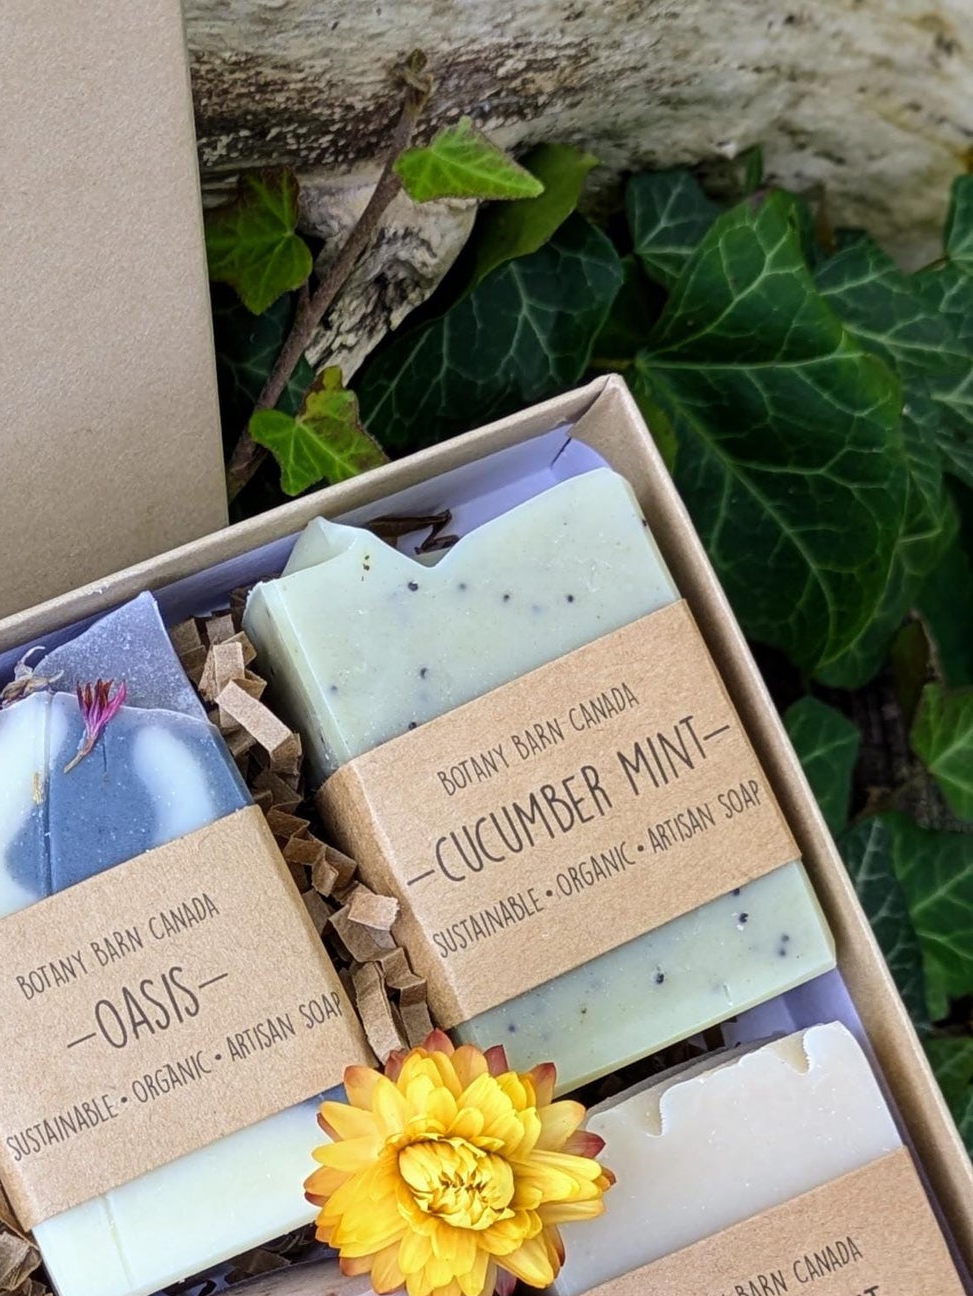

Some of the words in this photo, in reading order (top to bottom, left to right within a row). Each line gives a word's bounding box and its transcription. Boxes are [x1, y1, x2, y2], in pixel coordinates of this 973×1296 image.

[437, 743, 510, 796] BOTANY
[511, 717, 565, 760] BARN
[569, 682, 640, 732] CANADA
[432, 888, 544, 959] SUSTAINABLE
[556, 841, 636, 897] ORGANIC
[647, 806, 715, 854] ARTISAN
[725, 779, 762, 819] SOAP
[16, 951, 87, 1000] BOTANY
[90, 927, 142, 966] BARN
[149, 892, 220, 940] CANADA
[6, 1094, 118, 1161] SUSTAINABLE
[132, 1051, 212, 1103] ORGANIC
[226, 1015, 296, 1062] ARTISAN
[299, 992, 343, 1029] SOAP
[793, 1236, 863, 1283] CANADA
